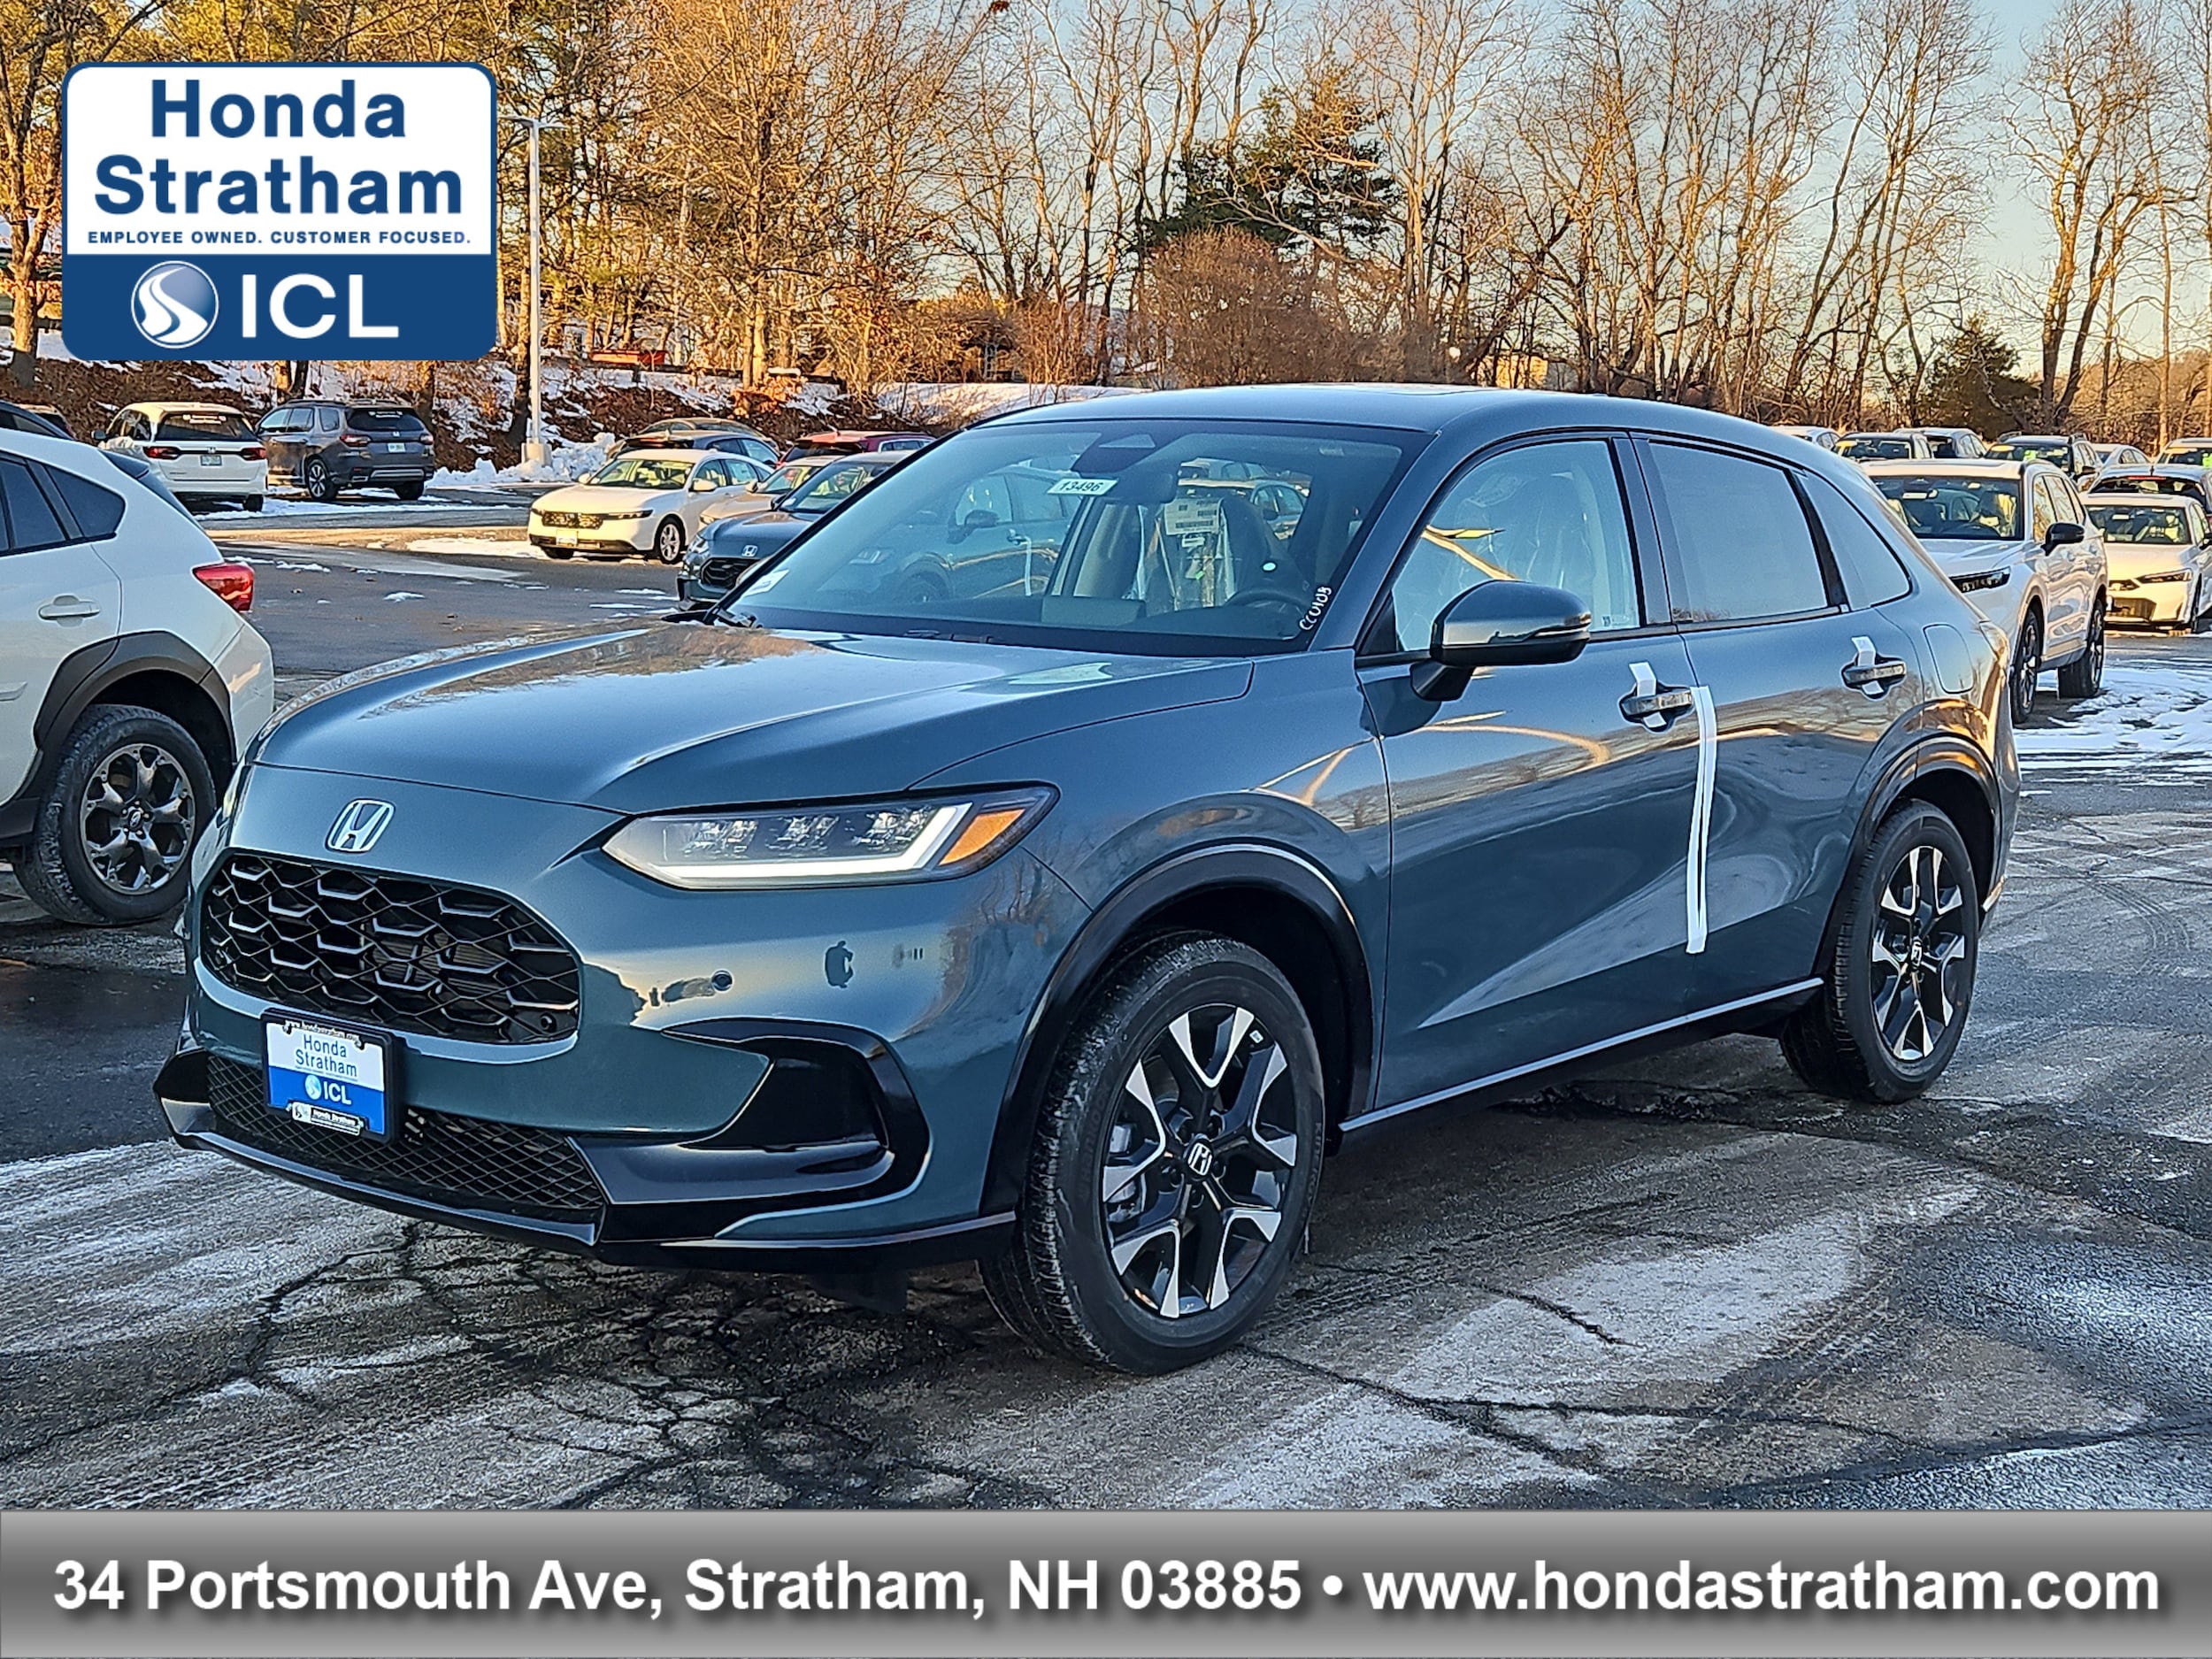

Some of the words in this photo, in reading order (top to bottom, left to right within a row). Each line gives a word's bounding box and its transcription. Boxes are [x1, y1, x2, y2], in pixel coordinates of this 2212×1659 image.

[1058, 480, 1104, 492] 13496
[303, 1033, 348, 1058] Honda
[295, 1048, 358, 1078] Stratham
[323, 1080, 352, 1105] ICL
